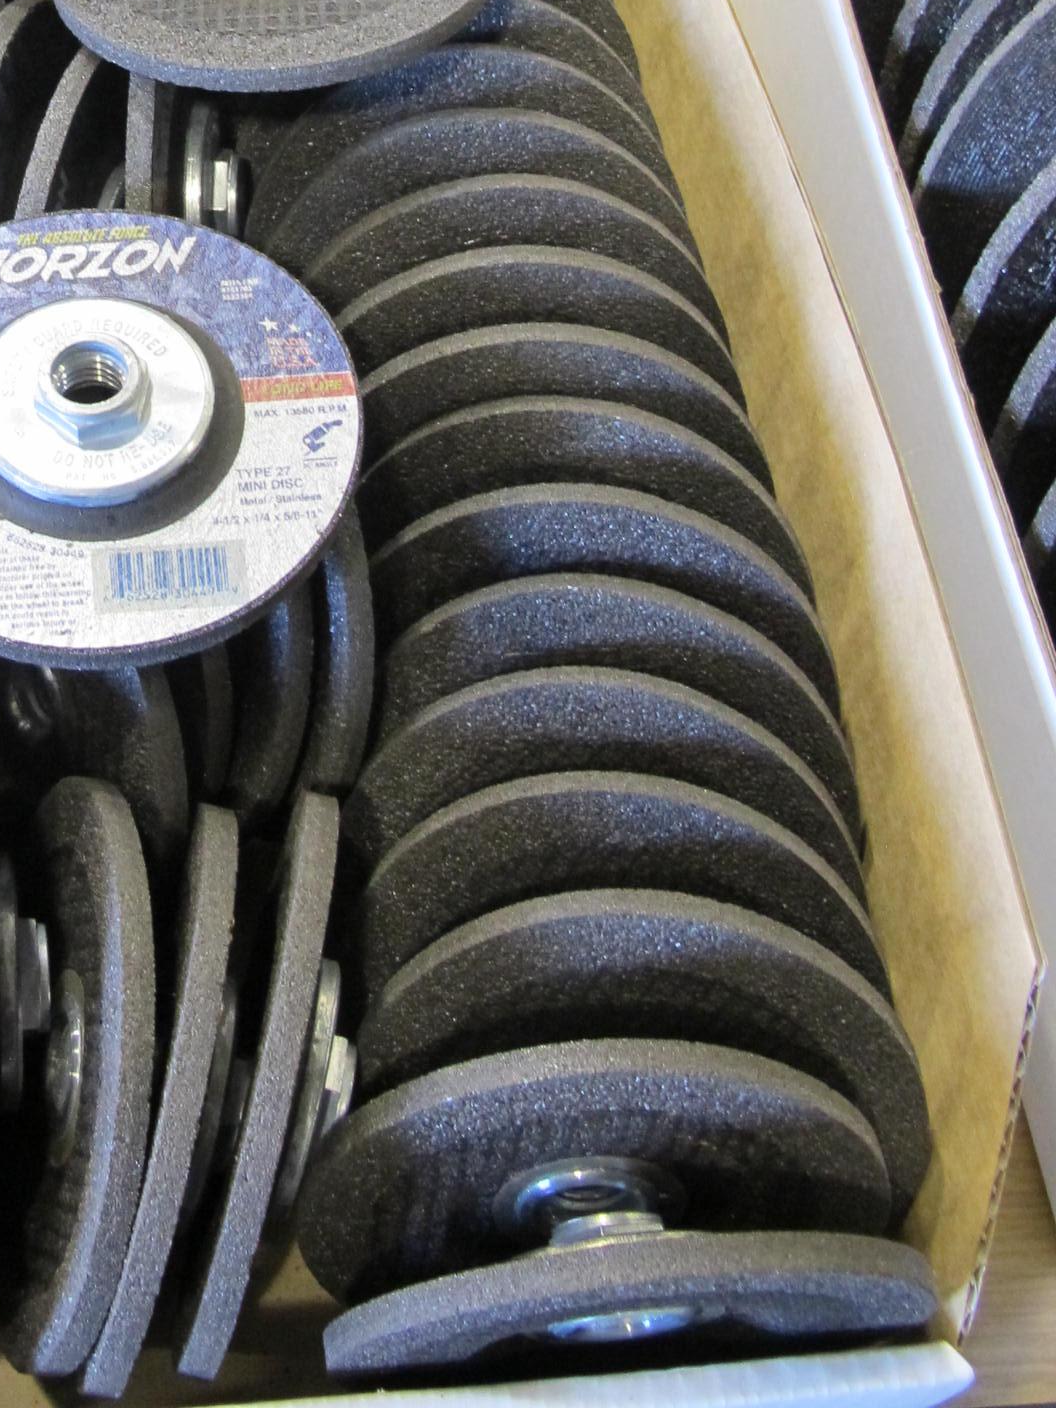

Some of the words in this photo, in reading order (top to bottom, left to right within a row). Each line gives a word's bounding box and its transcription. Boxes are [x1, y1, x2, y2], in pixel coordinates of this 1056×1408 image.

[235, 468, 274, 480] TYPE
[276, 465, 292, 477] 27
[237, 480, 268, 492] MINI
[271, 478, 305, 490] DISC
